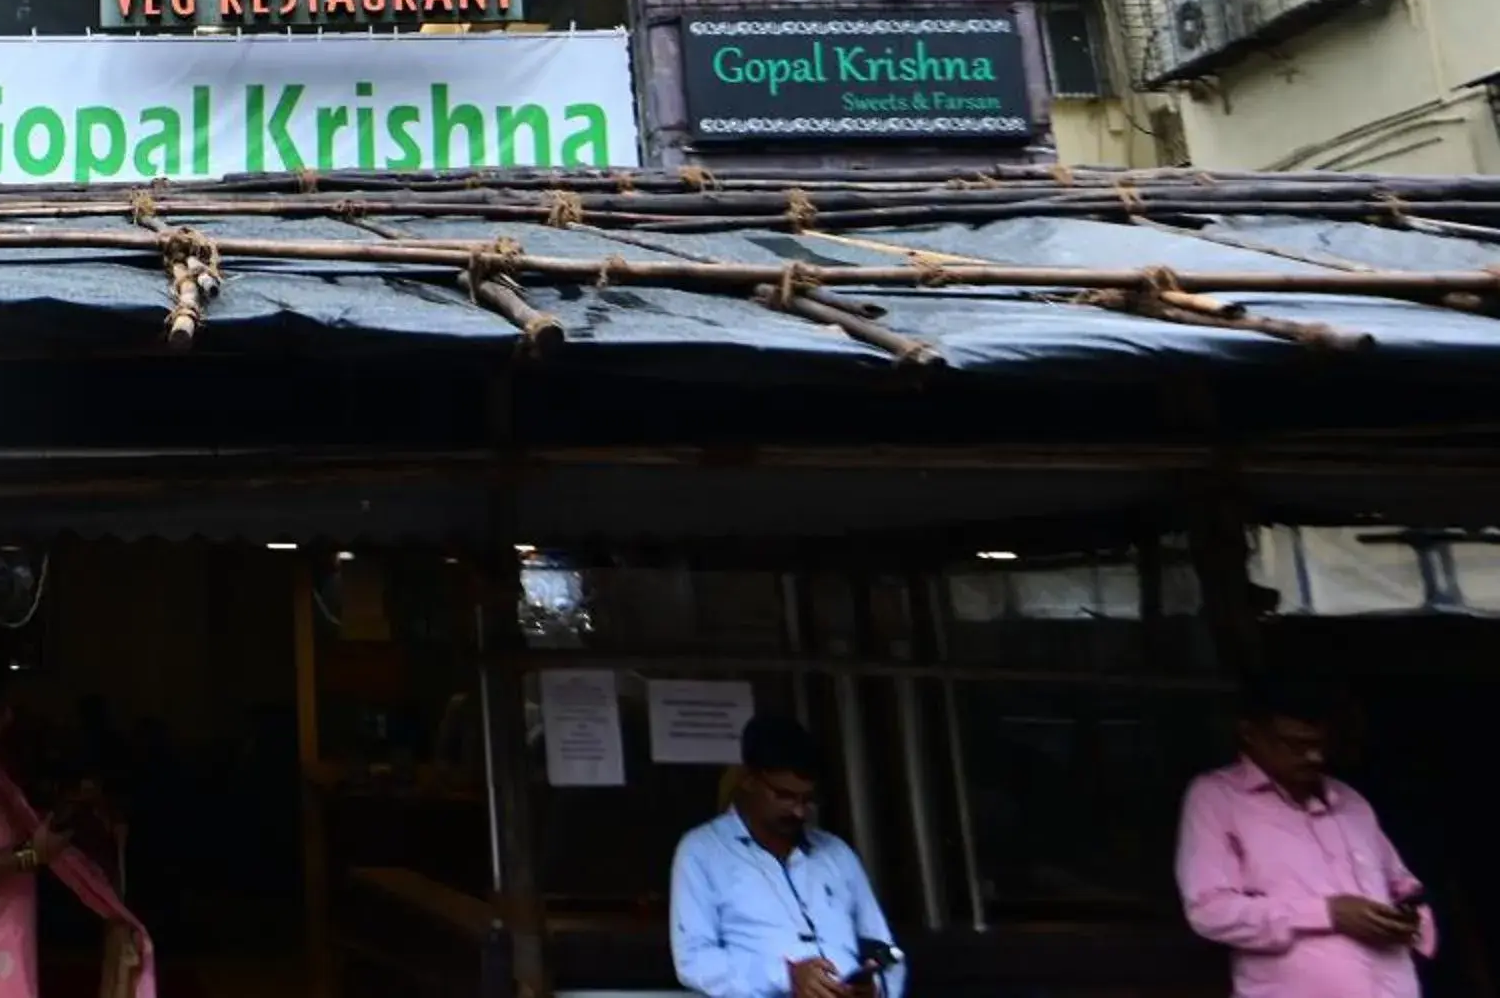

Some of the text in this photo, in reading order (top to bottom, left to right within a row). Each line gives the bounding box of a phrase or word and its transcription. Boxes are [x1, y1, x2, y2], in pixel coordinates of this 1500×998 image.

[712, 40, 997, 96] Gopal Krishna
[244, 80, 611, 173] Krishna
[841, 89, 1001, 112] Sweets & Farsan
